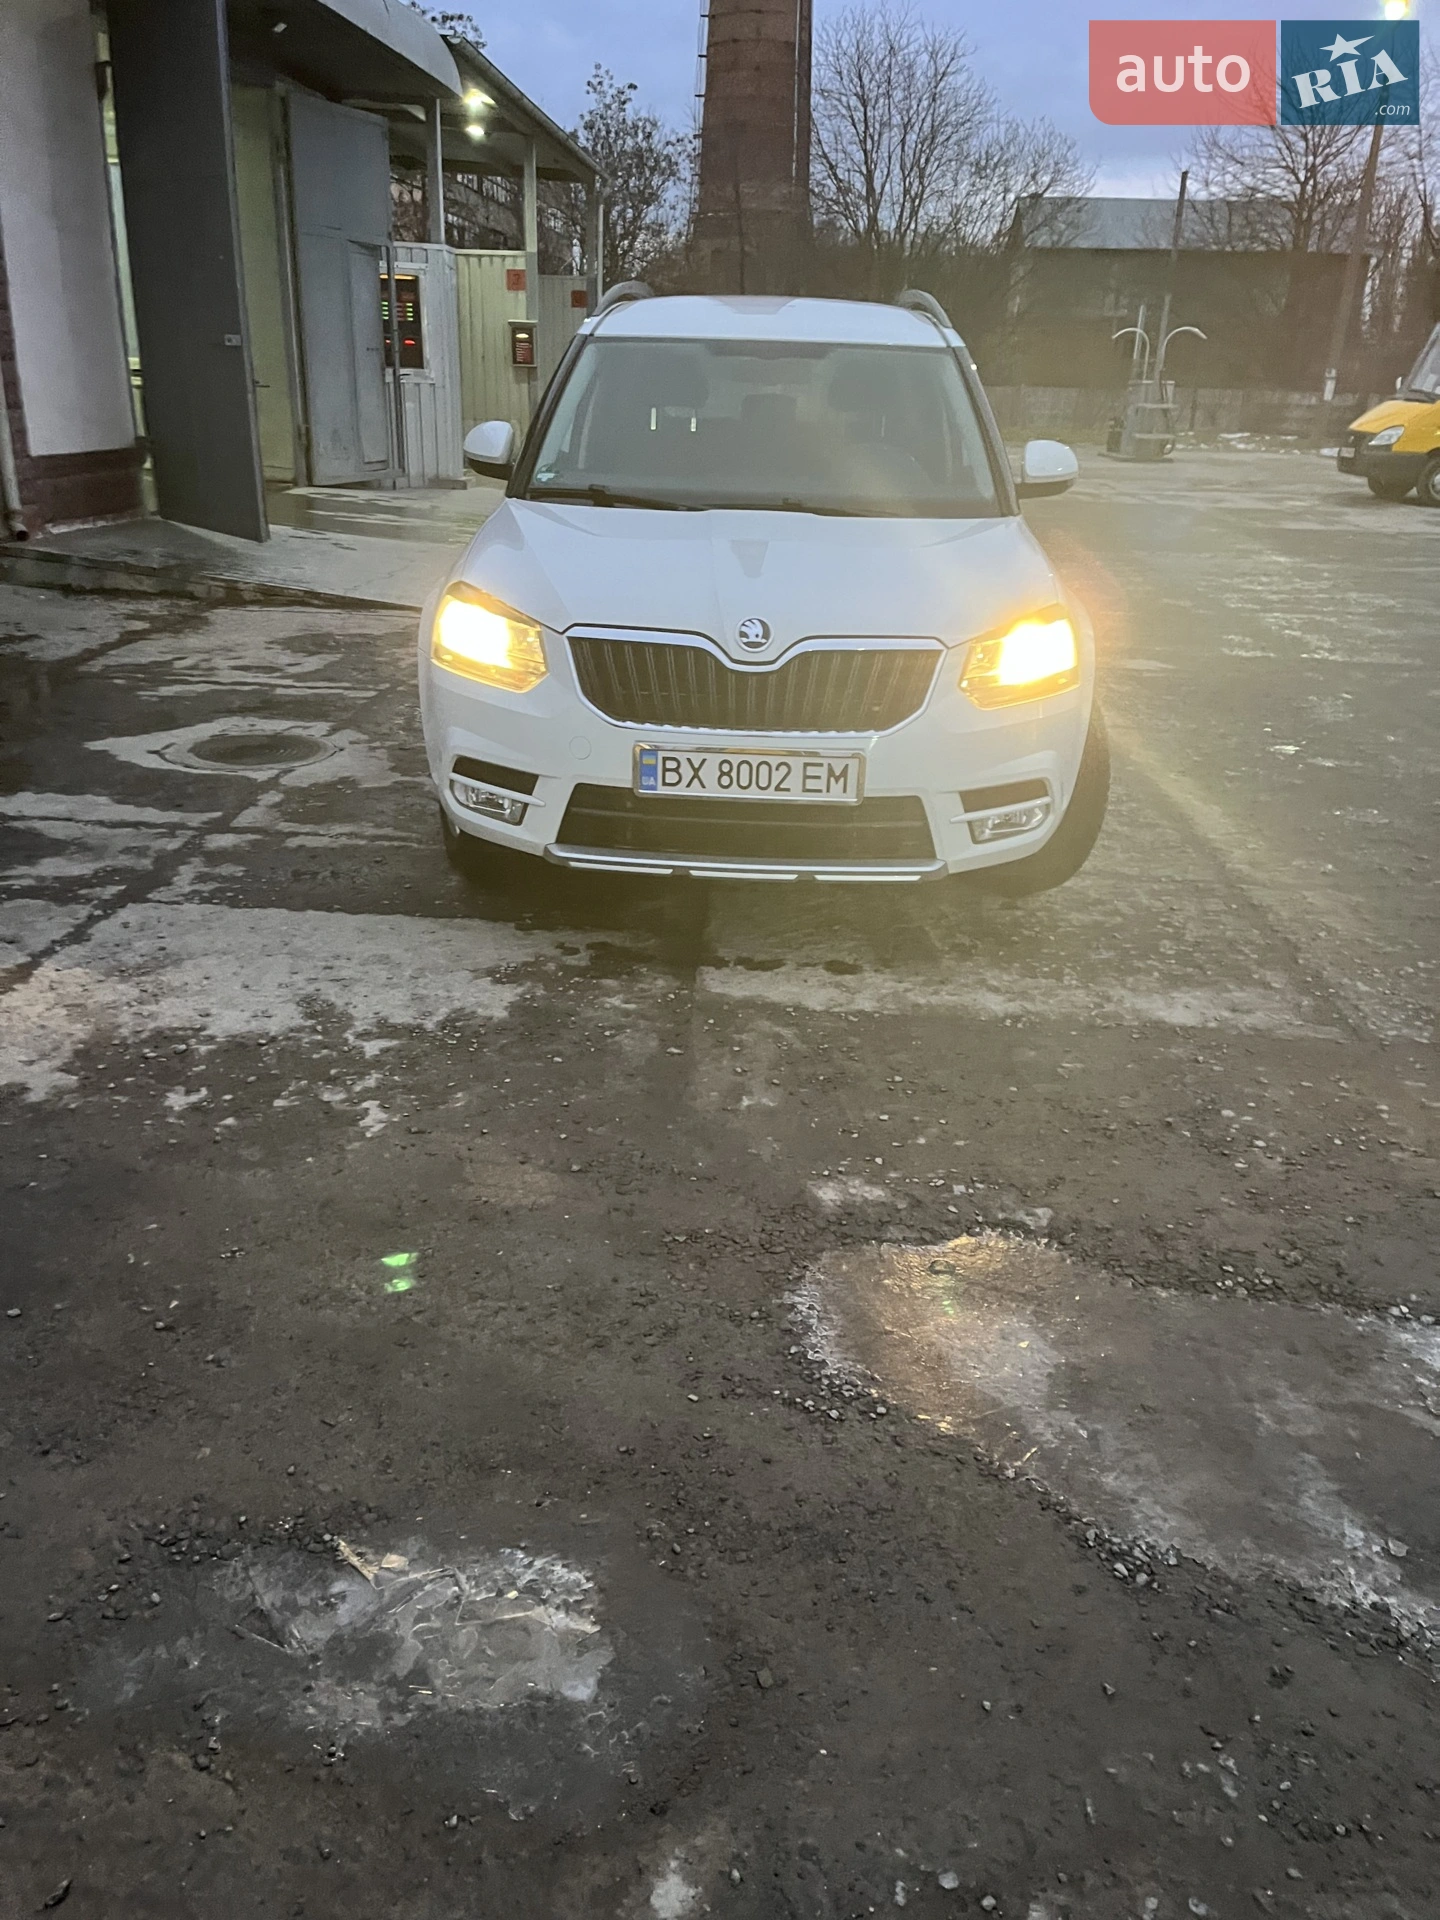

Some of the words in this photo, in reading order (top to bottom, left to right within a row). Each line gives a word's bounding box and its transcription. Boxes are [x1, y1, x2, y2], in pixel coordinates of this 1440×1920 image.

[641, 776, 657, 786] UA
[661, 756, 707, 788] BX
[717, 759, 792, 792] 8002
[801, 762, 850, 794] EM
